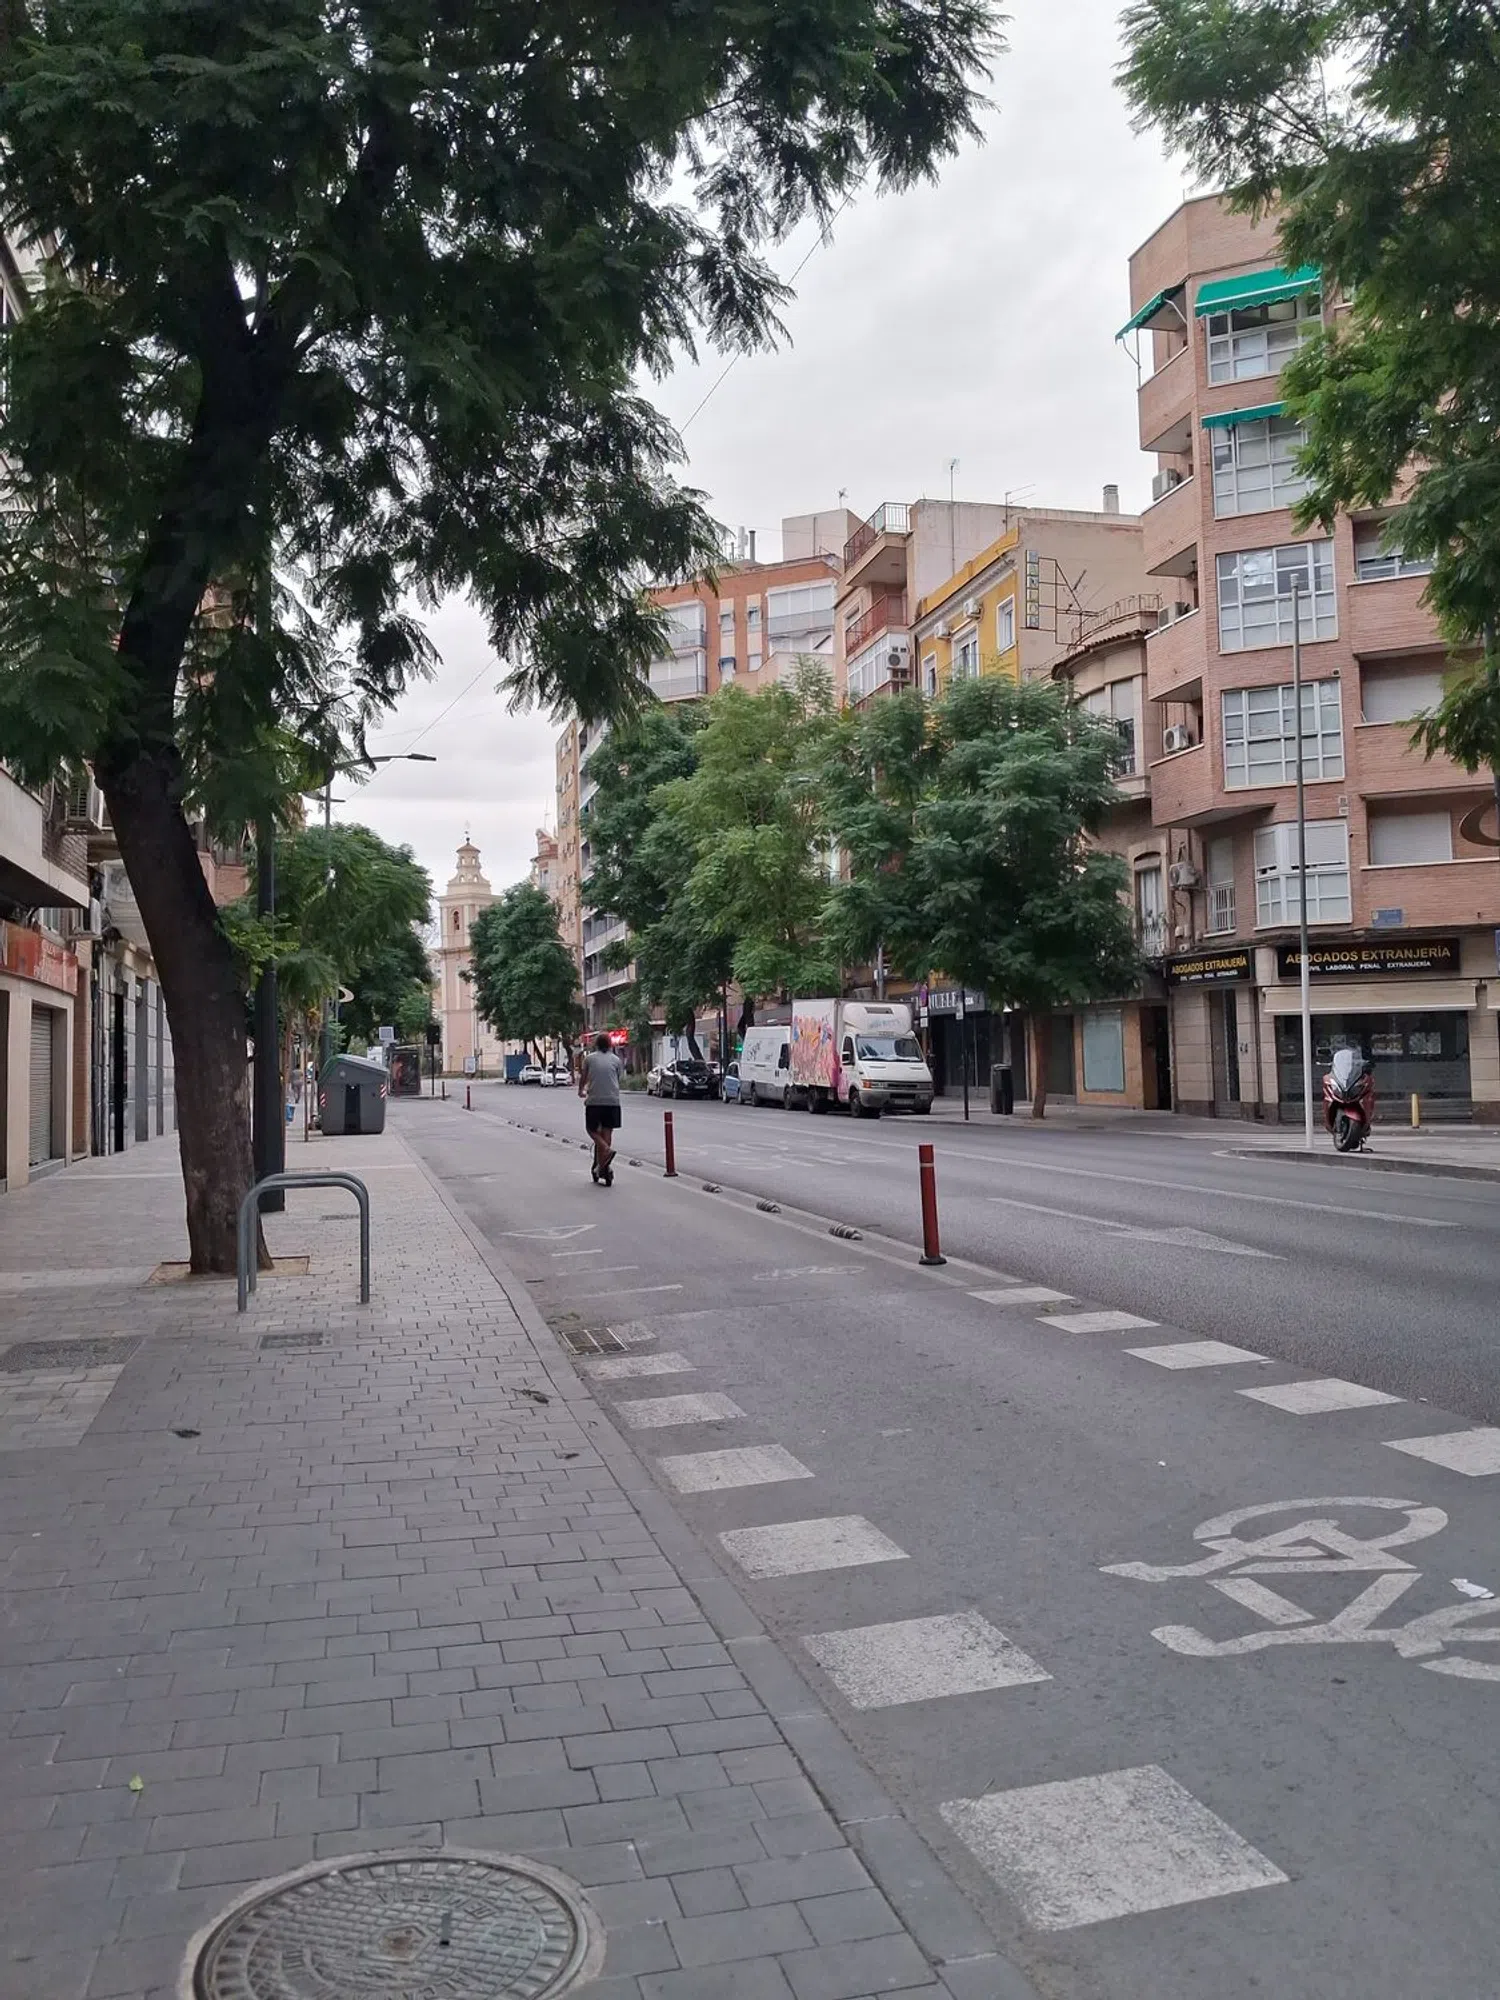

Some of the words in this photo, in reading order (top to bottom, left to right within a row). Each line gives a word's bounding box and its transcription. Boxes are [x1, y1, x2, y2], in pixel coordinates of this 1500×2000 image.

[1171, 962, 1204, 975] ABOGADOS
[1205, 955, 1247, 970] EXTRANJERÍA
[1285, 951, 1358, 965] ABOGADOS
[1361, 945, 1451, 960] EXTRANJERÍA
[1360, 962, 1381, 970] PENAL
